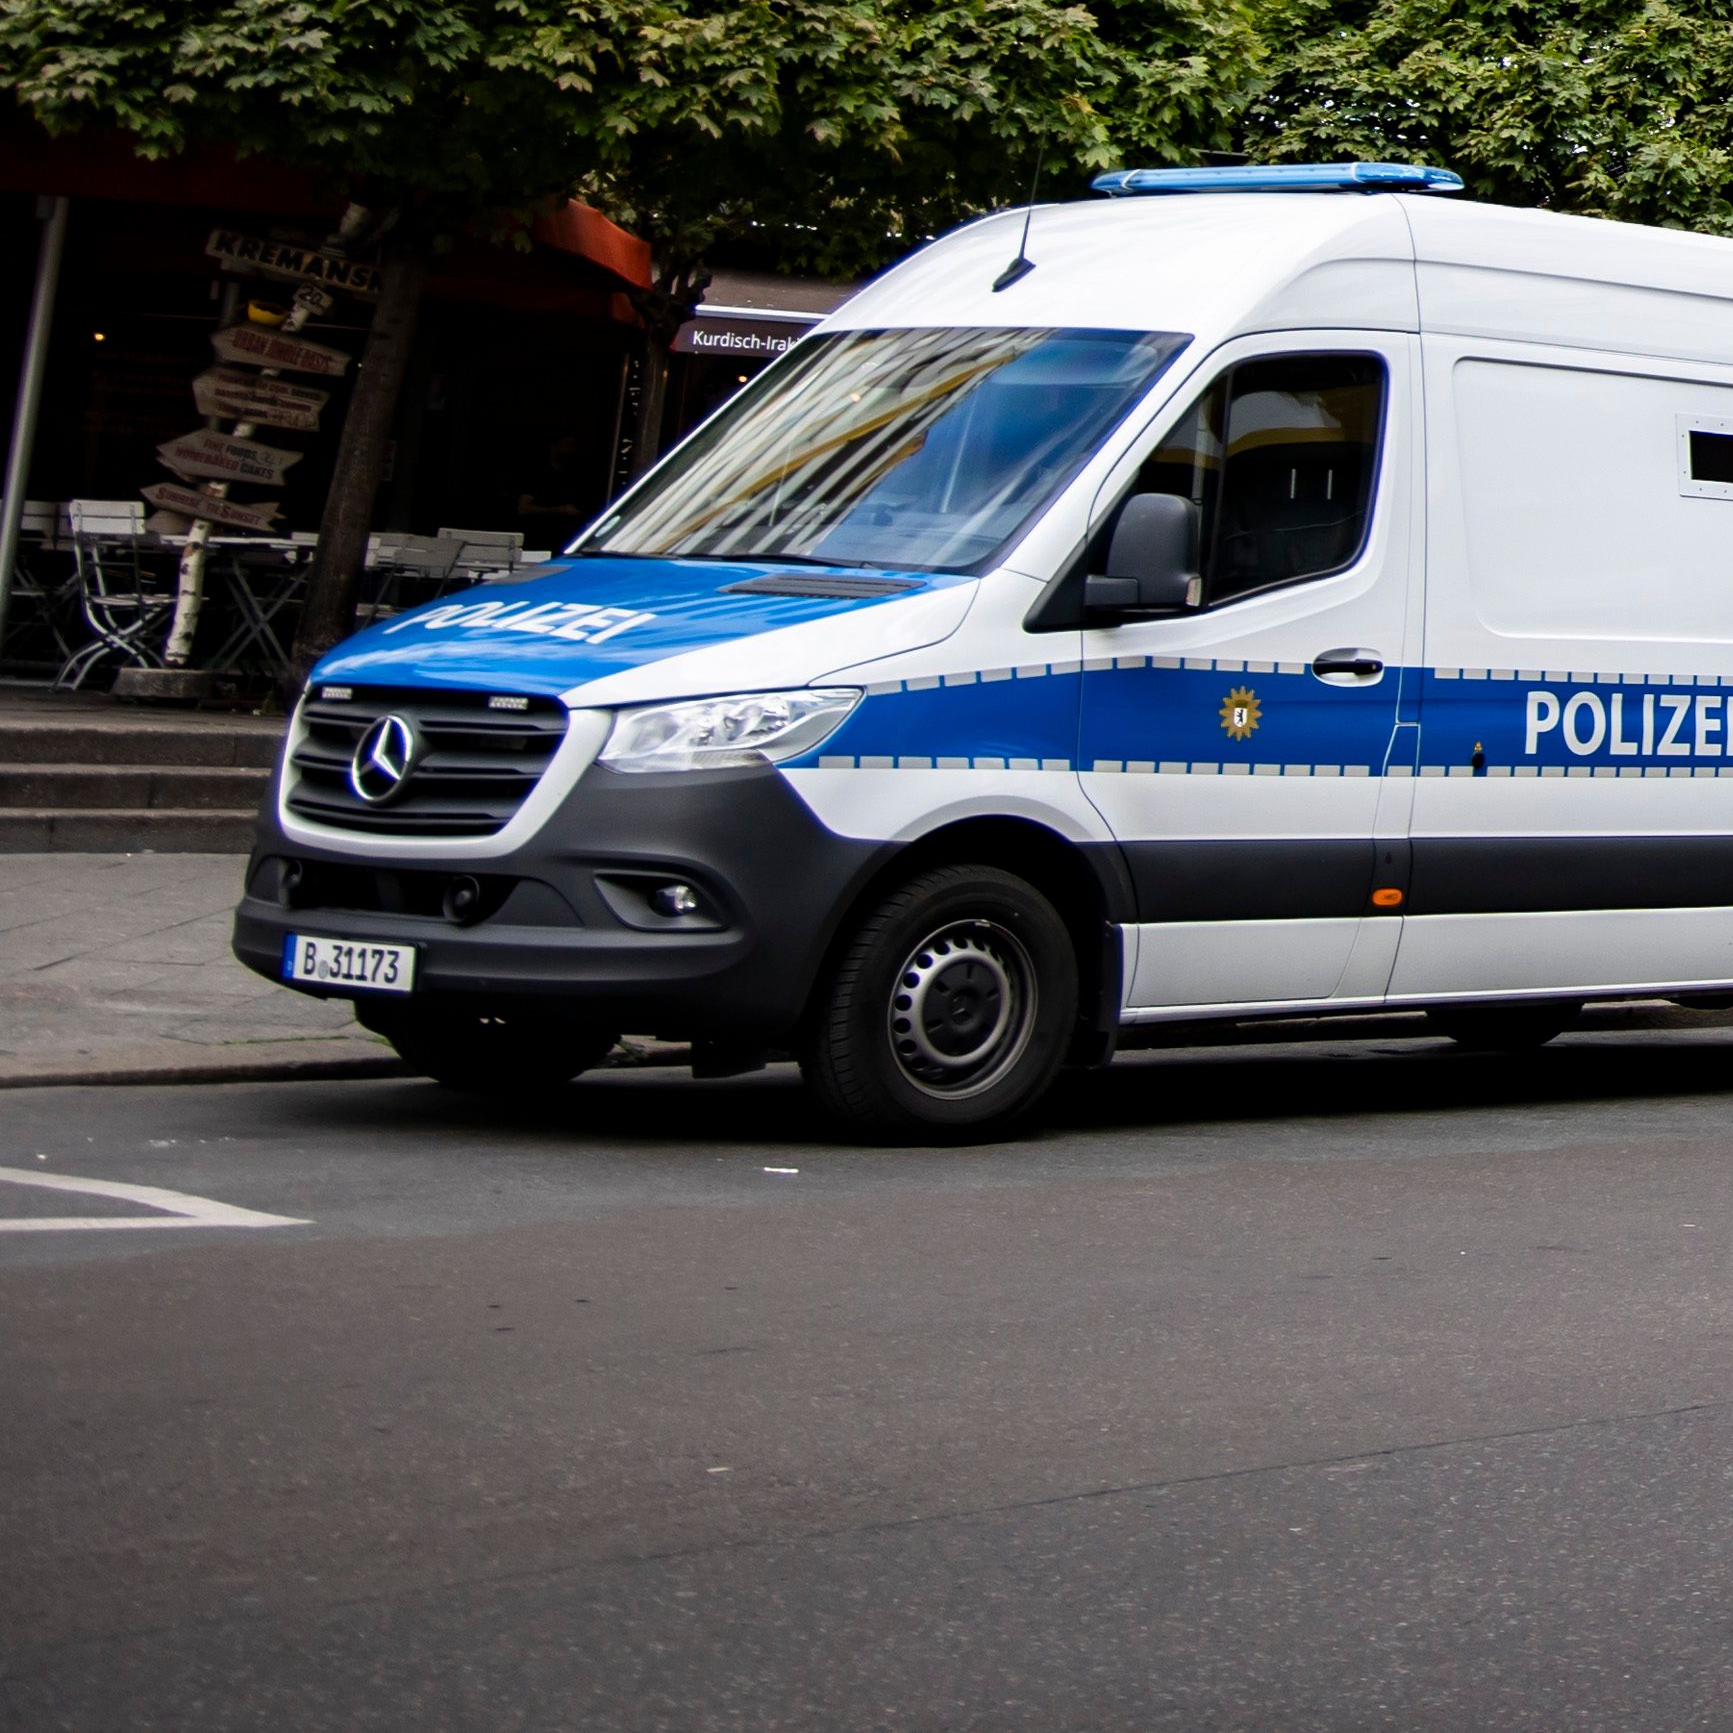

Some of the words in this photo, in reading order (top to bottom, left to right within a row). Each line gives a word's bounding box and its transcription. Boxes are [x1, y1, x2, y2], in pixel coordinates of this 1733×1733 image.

[693, 330, 800, 352] Kurdisch-Irak
[240, 463, 274, 479] CAKES
[382, 601, 657, 644] POLIZEI
[303, 941, 317, 975] B
[329, 945, 400, 984] 31173
